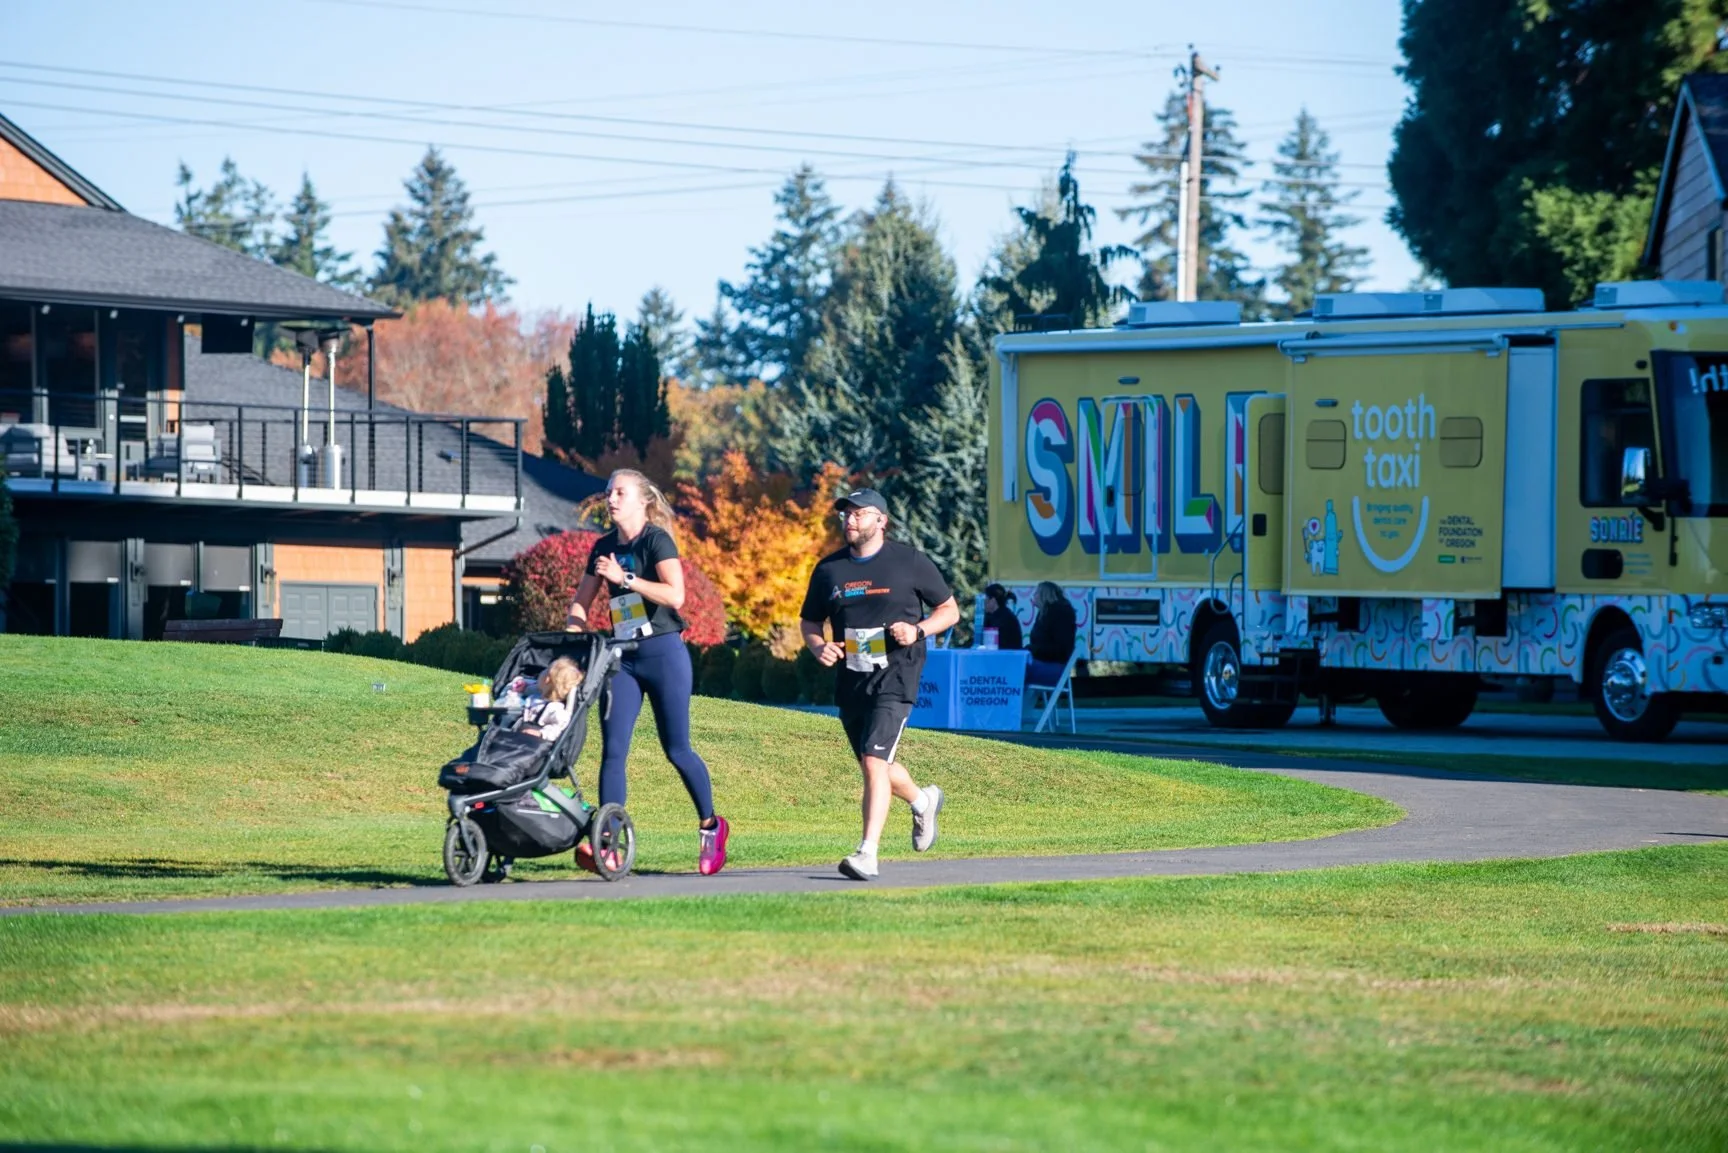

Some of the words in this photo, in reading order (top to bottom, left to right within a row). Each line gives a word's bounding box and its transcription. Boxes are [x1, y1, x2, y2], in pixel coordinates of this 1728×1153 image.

[1352, 392, 1436, 440] tooth
[1364, 443, 1420, 488] taxi
[1439, 526, 1483, 536] FOUNDATION
[1446, 538, 1476, 548] OREGON
[970, 676, 1008, 685] DENTAL
[966, 697, 1009, 706] OREGON
